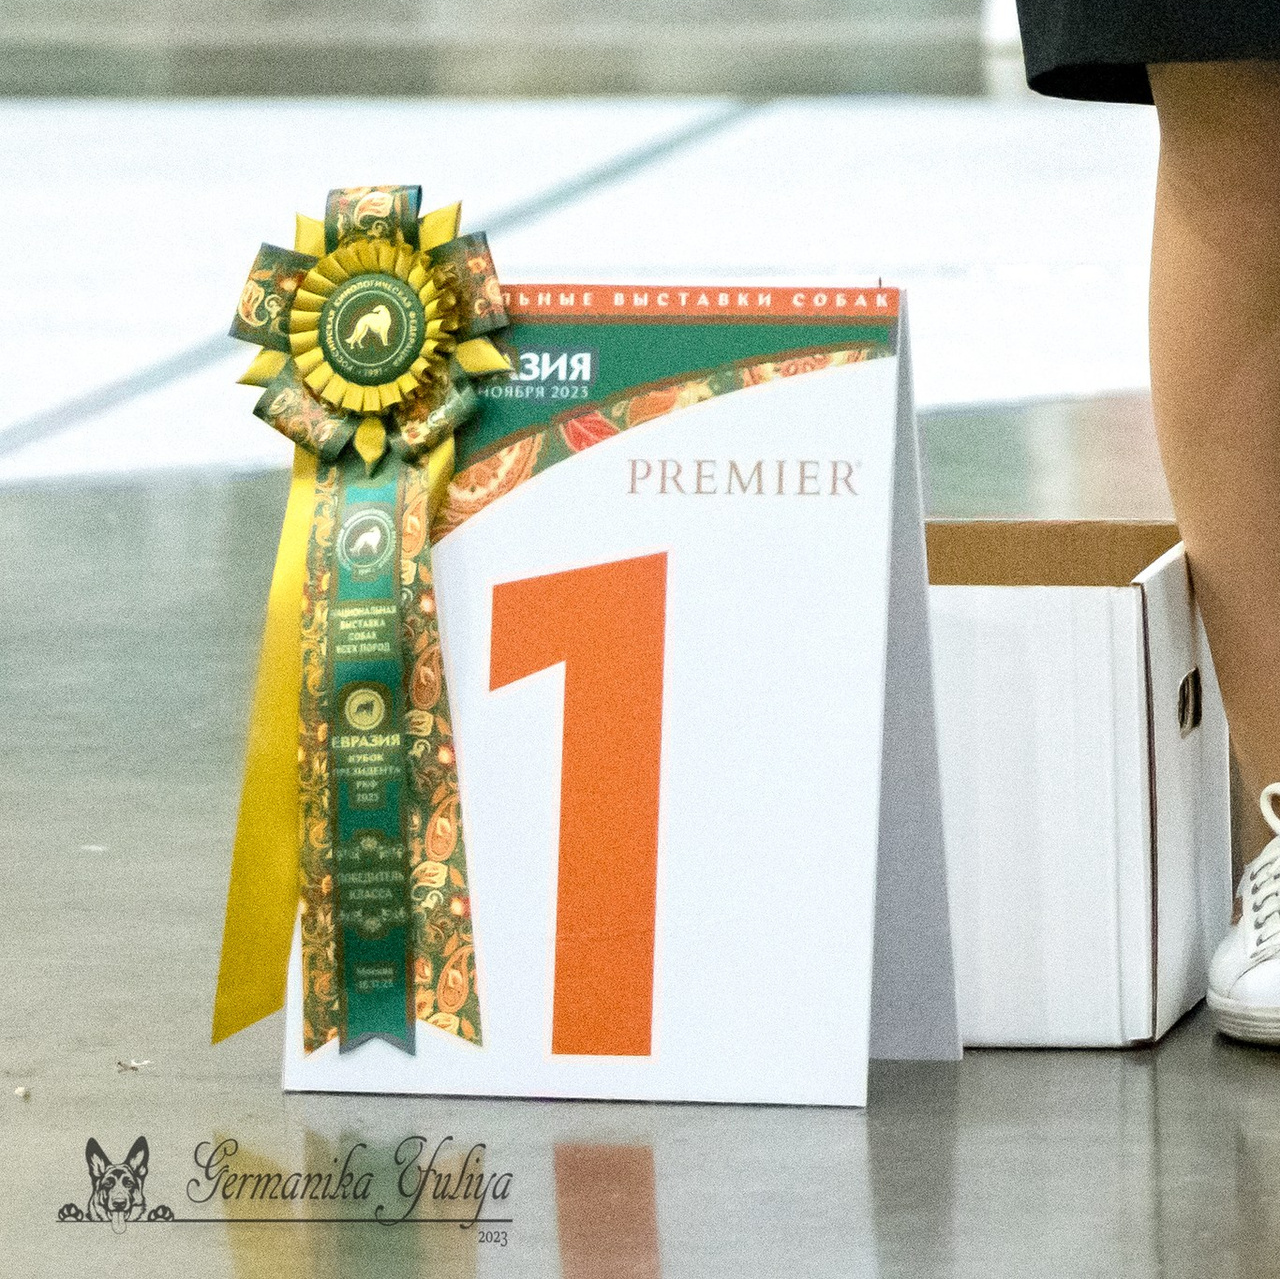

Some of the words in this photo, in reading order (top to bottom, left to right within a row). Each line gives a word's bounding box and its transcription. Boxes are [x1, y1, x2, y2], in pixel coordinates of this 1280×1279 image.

[614, 292, 773, 308] ВЫСТАВКИ
[792, 292, 889, 309] СОБАК
[551, 385, 589, 398] 2023
[626, 457, 859, 497] PREMIER
[339, 619, 386, 630] ВЫСТАВКА
[348, 631, 377, 642] СОБАК
[331, 733, 400, 749] ЕВРАЗИЯ
[348, 753, 384, 764] КУБОК
[488, 551, 669, 1057] 1
